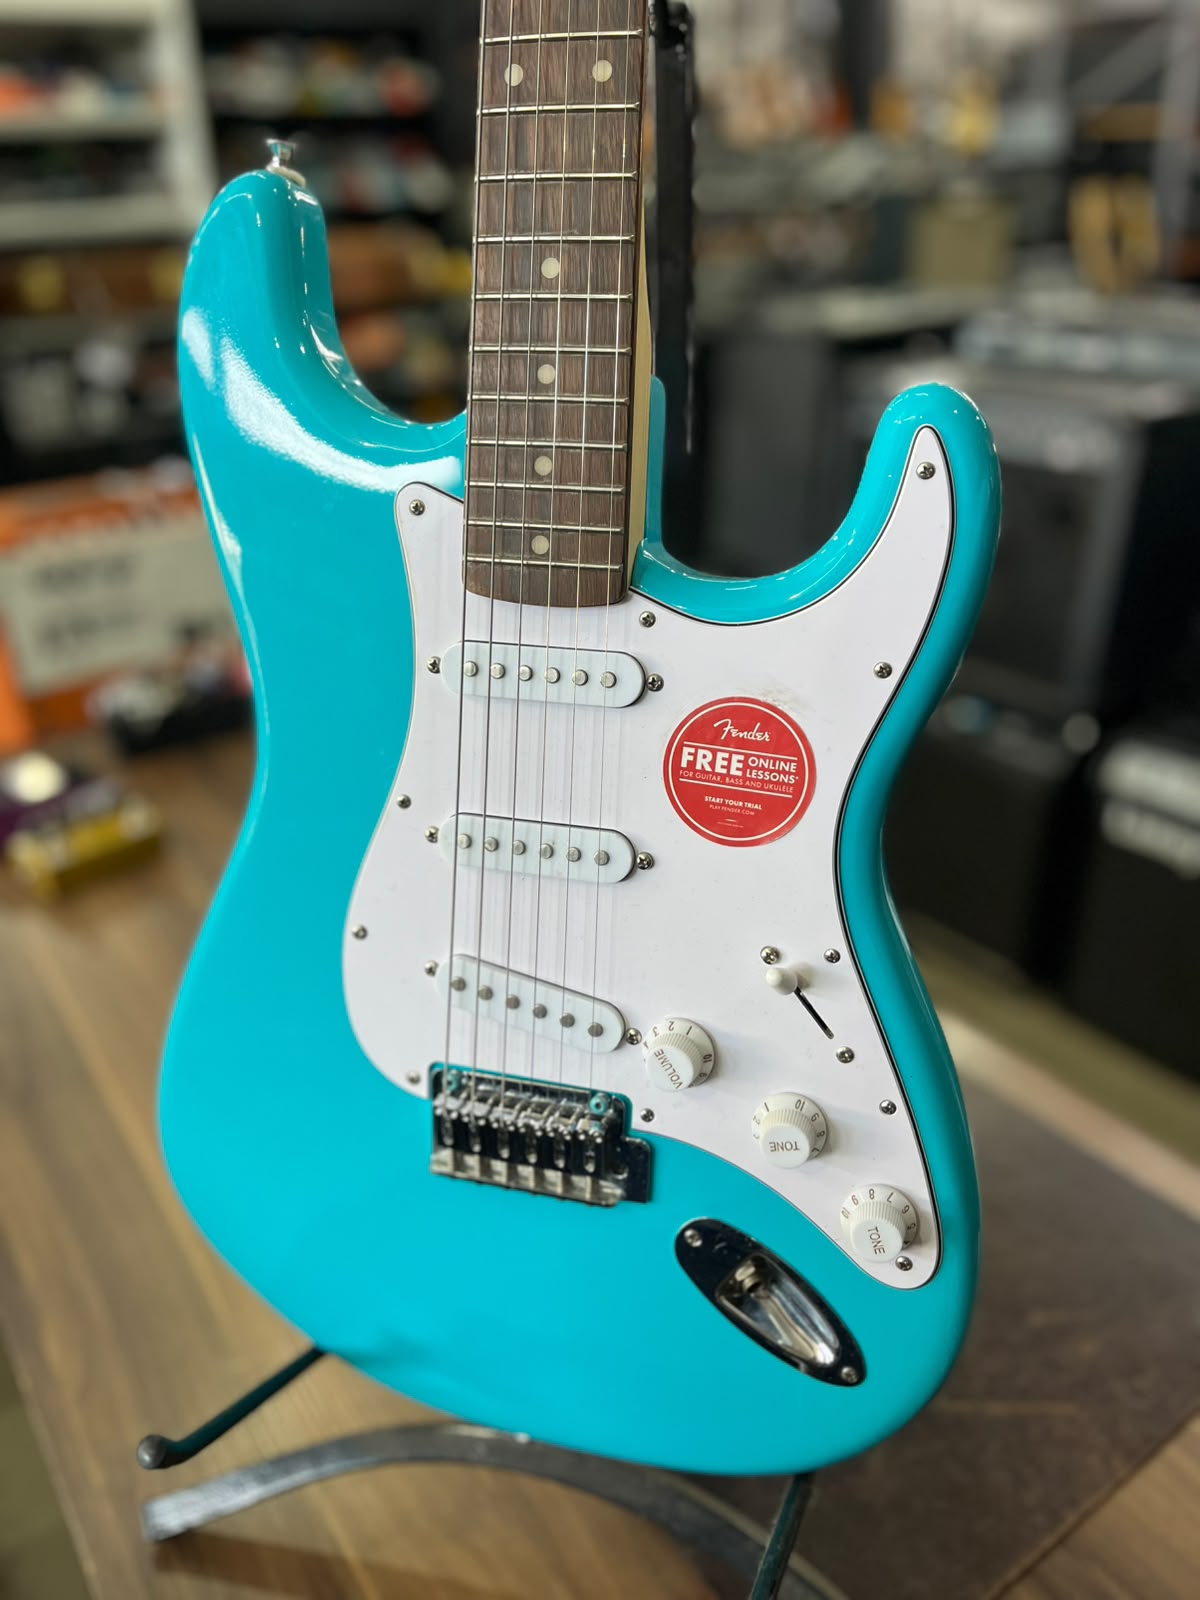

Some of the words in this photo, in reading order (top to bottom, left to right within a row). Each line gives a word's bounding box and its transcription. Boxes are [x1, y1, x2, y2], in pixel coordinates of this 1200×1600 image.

[713, 718, 771, 742] Fender
[680, 746, 745, 776] FREE
[748, 756, 797, 773] ONLINE
[679, 770, 694, 778] FOR
[725, 777, 744, 786] BASS
[745, 780, 762, 788] AND
[763, 783, 794, 793] UKULELE
[704, 795, 723, 804] START
[724, 798, 743, 807] YOUR
[744, 801, 762, 810] TRIAL
[652, 1026, 660, 1037] 3
[668, 1020, 675, 1031] 2
[686, 1025, 693, 1035] 1
[703, 1054, 713, 1063] 10
[654, 1048, 684, 1090] VOLUME
[763, 1101, 770, 1112] 1
[794, 1098, 806, 1112] 10
[768, 1140, 800, 1153] TONE
[851, 1194, 859, 1206] 9
[868, 1188, 875, 1200] 8
[886, 1191, 894, 1204] 7
[841, 1206, 850, 1219] 10
[867, 1226, 886, 1255] TONE
